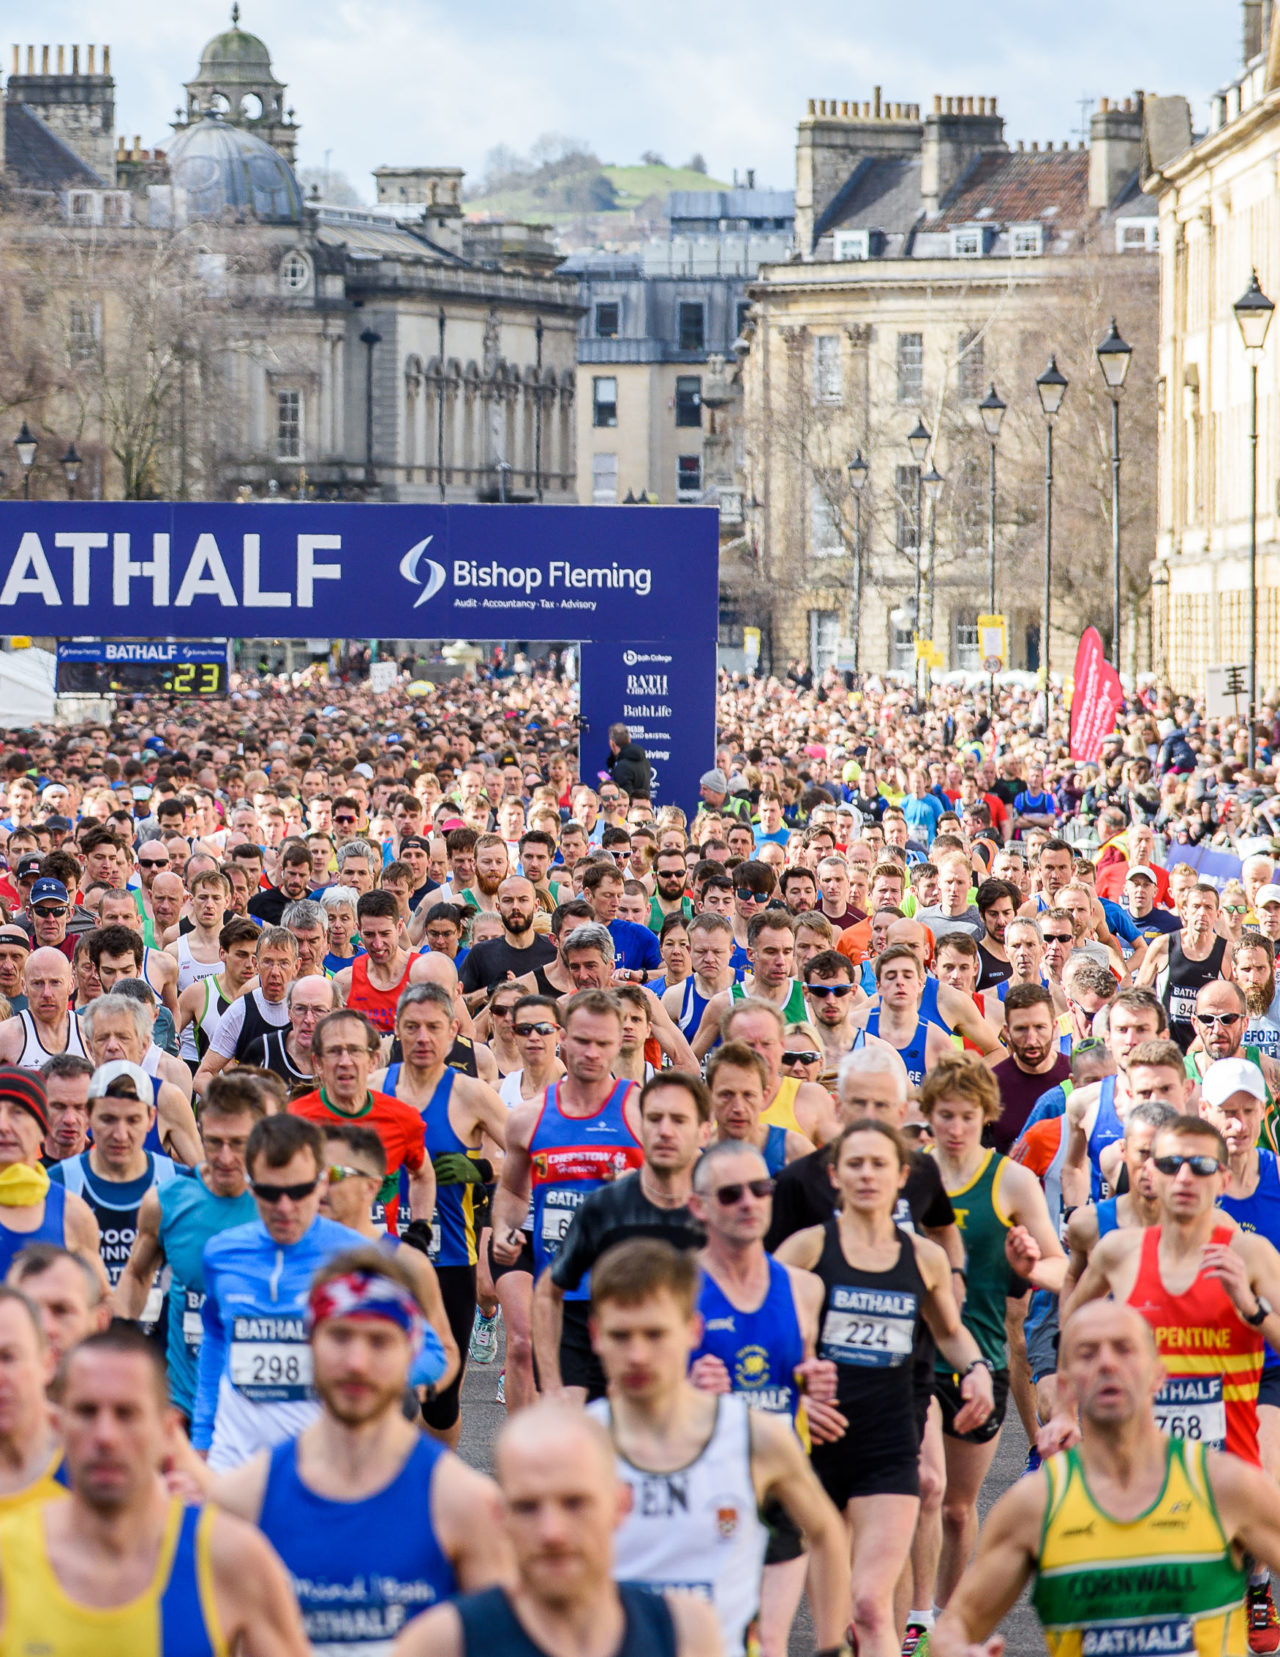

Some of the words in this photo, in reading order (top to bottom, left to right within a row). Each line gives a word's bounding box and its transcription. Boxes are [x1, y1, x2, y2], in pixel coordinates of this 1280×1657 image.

[453, 561, 542, 594] Bishop
[549, 562, 652, 596] Fleming
[454, 599, 477, 608] Audit
[482, 599, 536, 610] Accountancy
[540, 600, 555, 608] Tax
[560, 600, 597, 611] Advisory
[105, 645, 177, 660] BATHALF
[627, 675, 668, 689] BATH
[1173, 987, 1198, 999] BATH
[1243, 1030, 1280, 1042] EFORD
[548, 1151, 612, 1165] CHEPSTOW
[546, 1190, 584, 1206] BATH
[834, 1290, 915, 1316] BATHALF
[235, 1319, 307, 1340] BATHAL
[846, 1322, 888, 1347] 224
[1155, 1326, 1232, 1349] PENTINE
[253, 1356, 300, 1383] 298
[1070, 1566, 1197, 1599] CORNWALL
[1081, 1621, 1192, 1656] BATHALF
